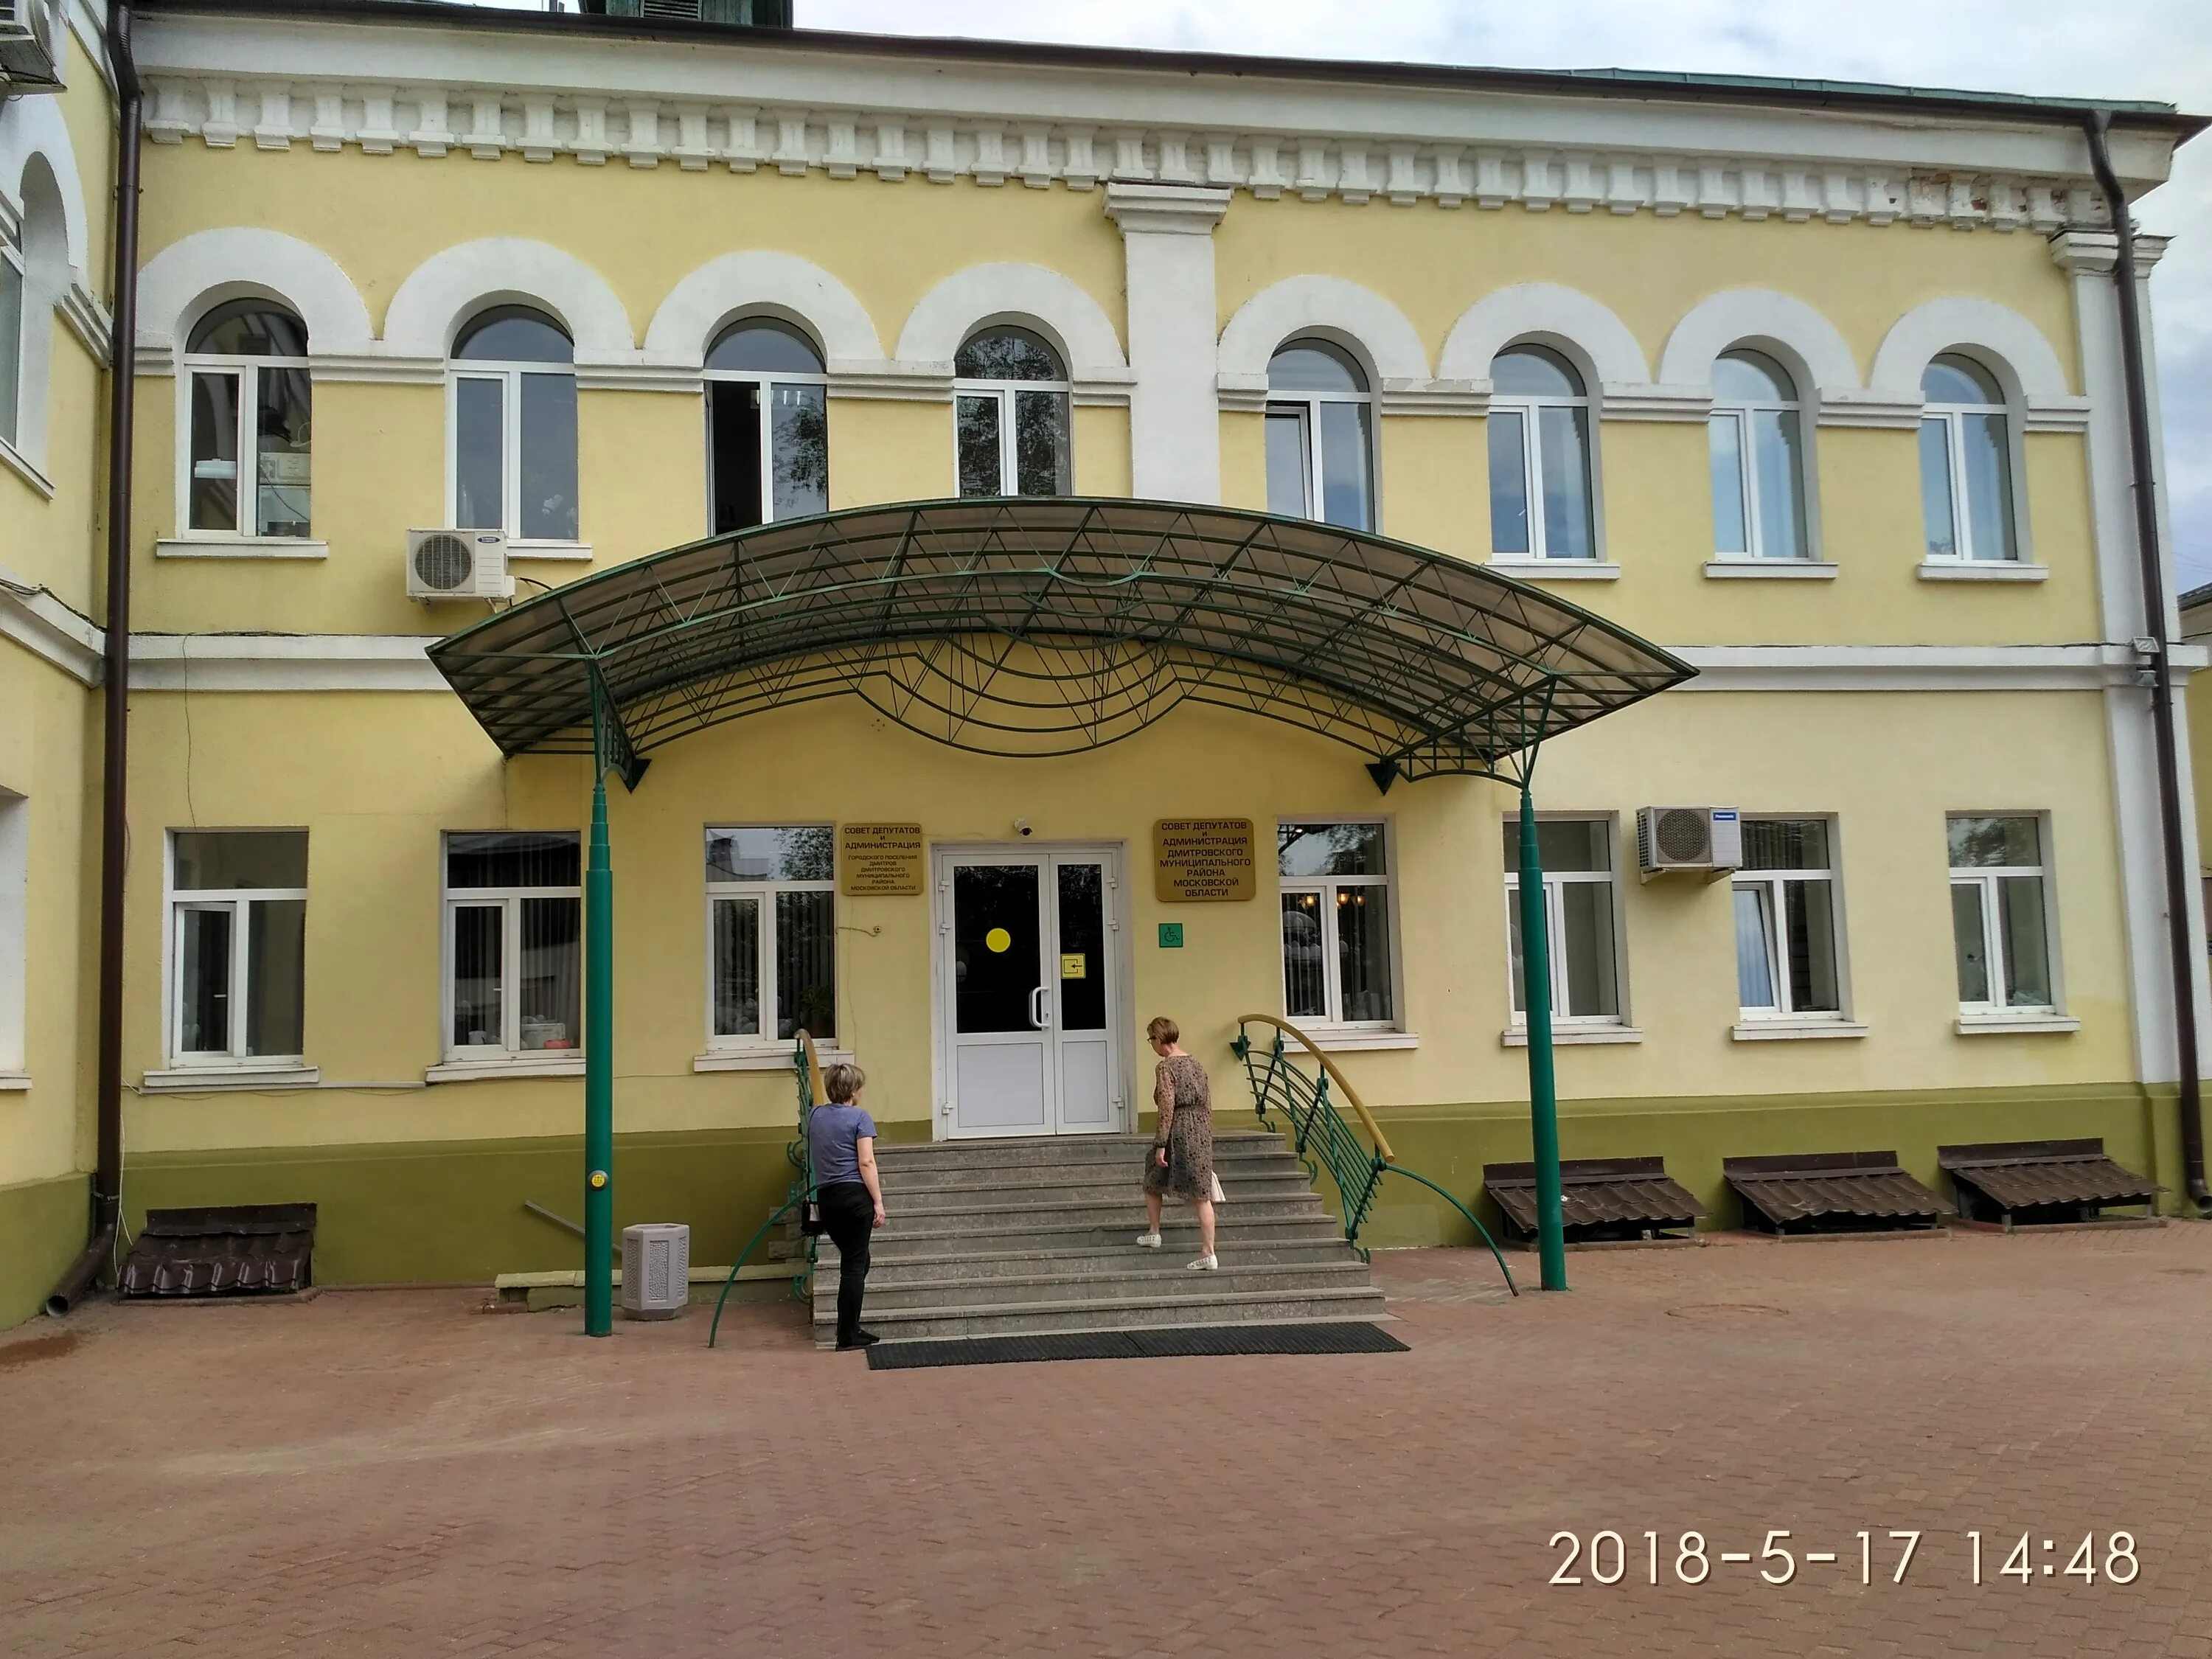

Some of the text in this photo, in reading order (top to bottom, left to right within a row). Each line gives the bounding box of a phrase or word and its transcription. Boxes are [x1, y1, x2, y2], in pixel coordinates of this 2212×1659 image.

[1193, 821, 1247, 830] ДЕПУТАТОВ
[1163, 837, 1248, 846] АДМИНИСТРАЦИЯ
[1167, 849, 1243, 858] ДМИТРОВСКОГО
[1160, 858, 1251, 868] МУНИЦИПАЛЬНОГО
[1186, 868, 1225, 877] РАЙОНА
[1173, 877, 1239, 887] МОСКОВСКОЙ
[1185, 888, 1228, 897] ОБЛАСТИ
